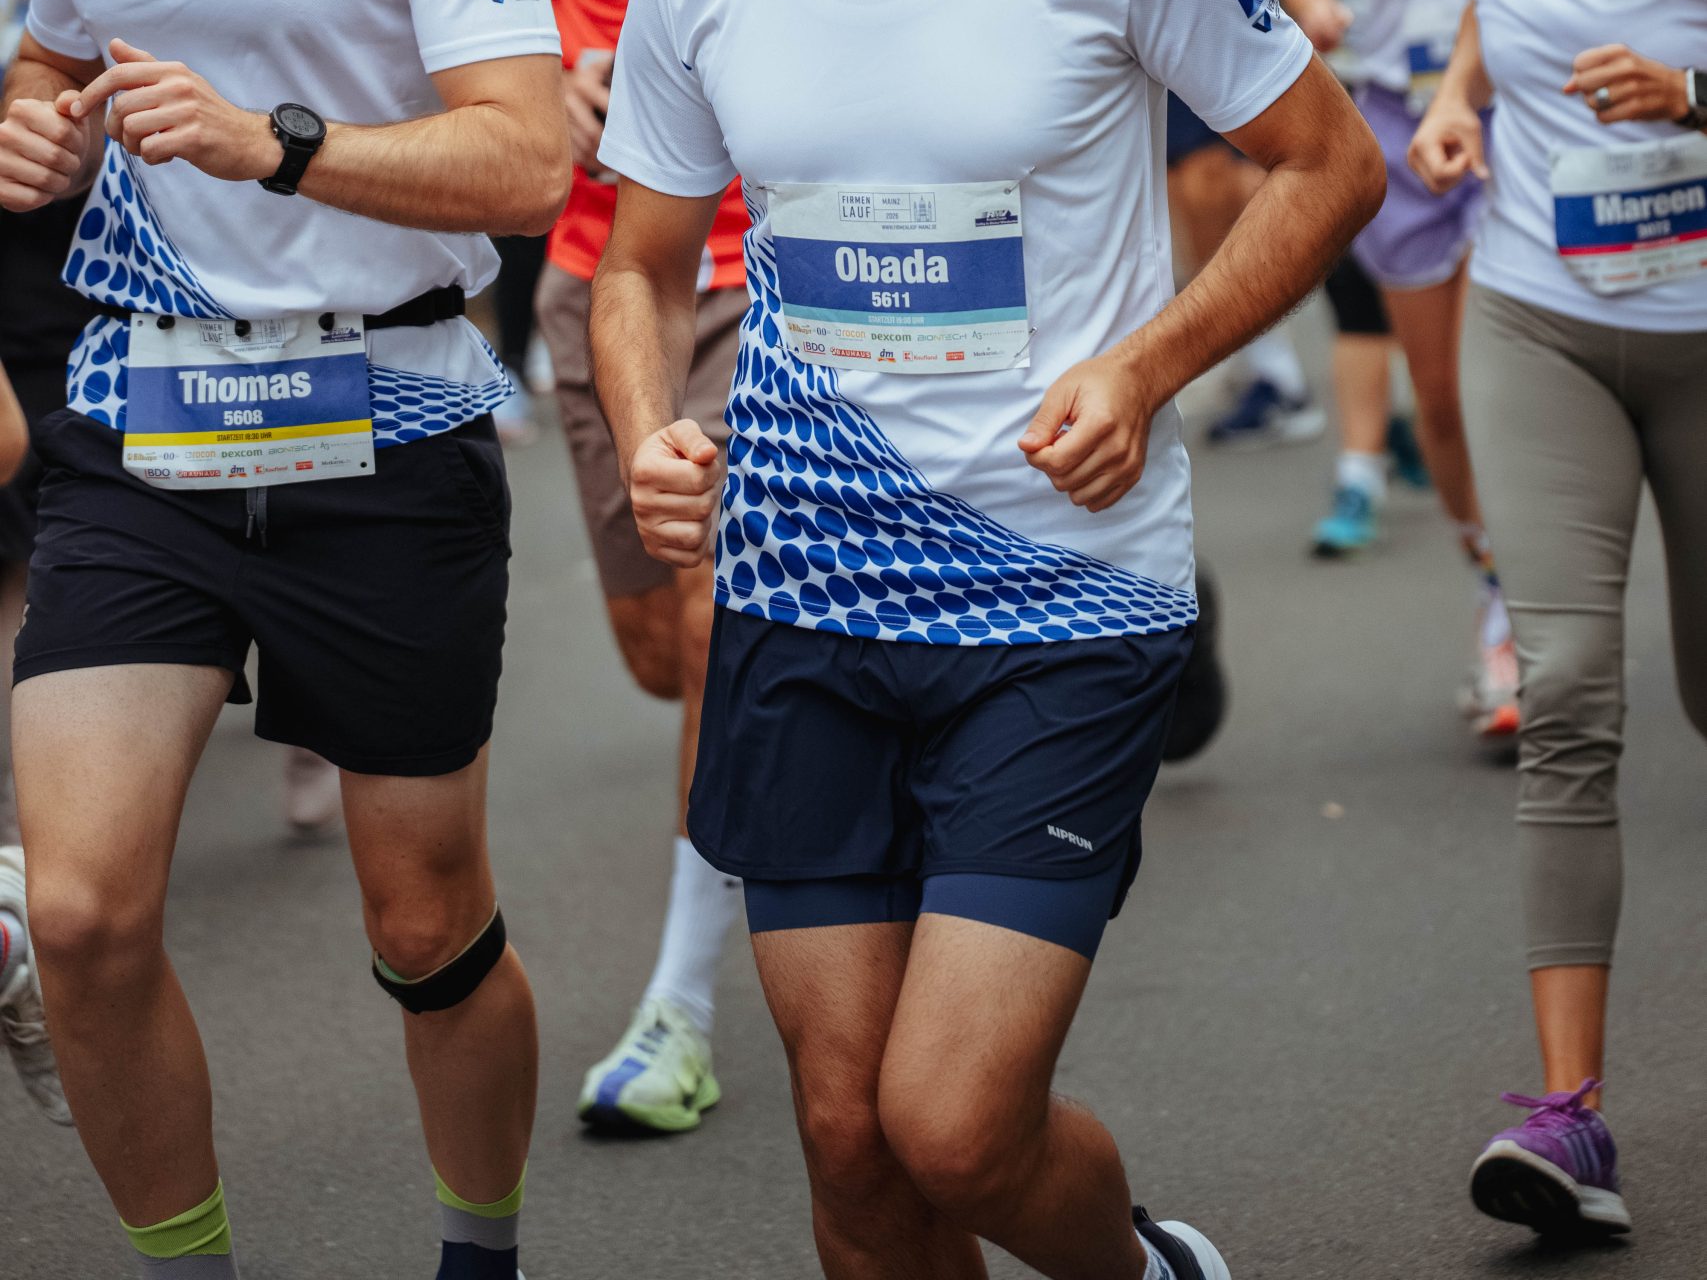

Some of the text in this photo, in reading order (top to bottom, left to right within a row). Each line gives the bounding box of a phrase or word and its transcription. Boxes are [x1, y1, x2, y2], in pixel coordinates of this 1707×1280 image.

[842, 195, 871, 204] FIRMEN
[1593, 186, 1705, 226] Mareen
[842, 206, 871, 218] LAUF
[834, 246, 949, 284] Obada
[871, 291, 911, 308] 5611
[203, 332, 223, 342] LAUF
[805, 341, 825, 352] BDO
[880, 349, 894, 358] dm
[178, 371, 311, 404] Thomas
[224, 410, 263, 426] 5608
[147, 469, 170, 477] BDO
[230, 465, 245, 473] dm
[1047, 824, 1093, 851] KIPRUN
